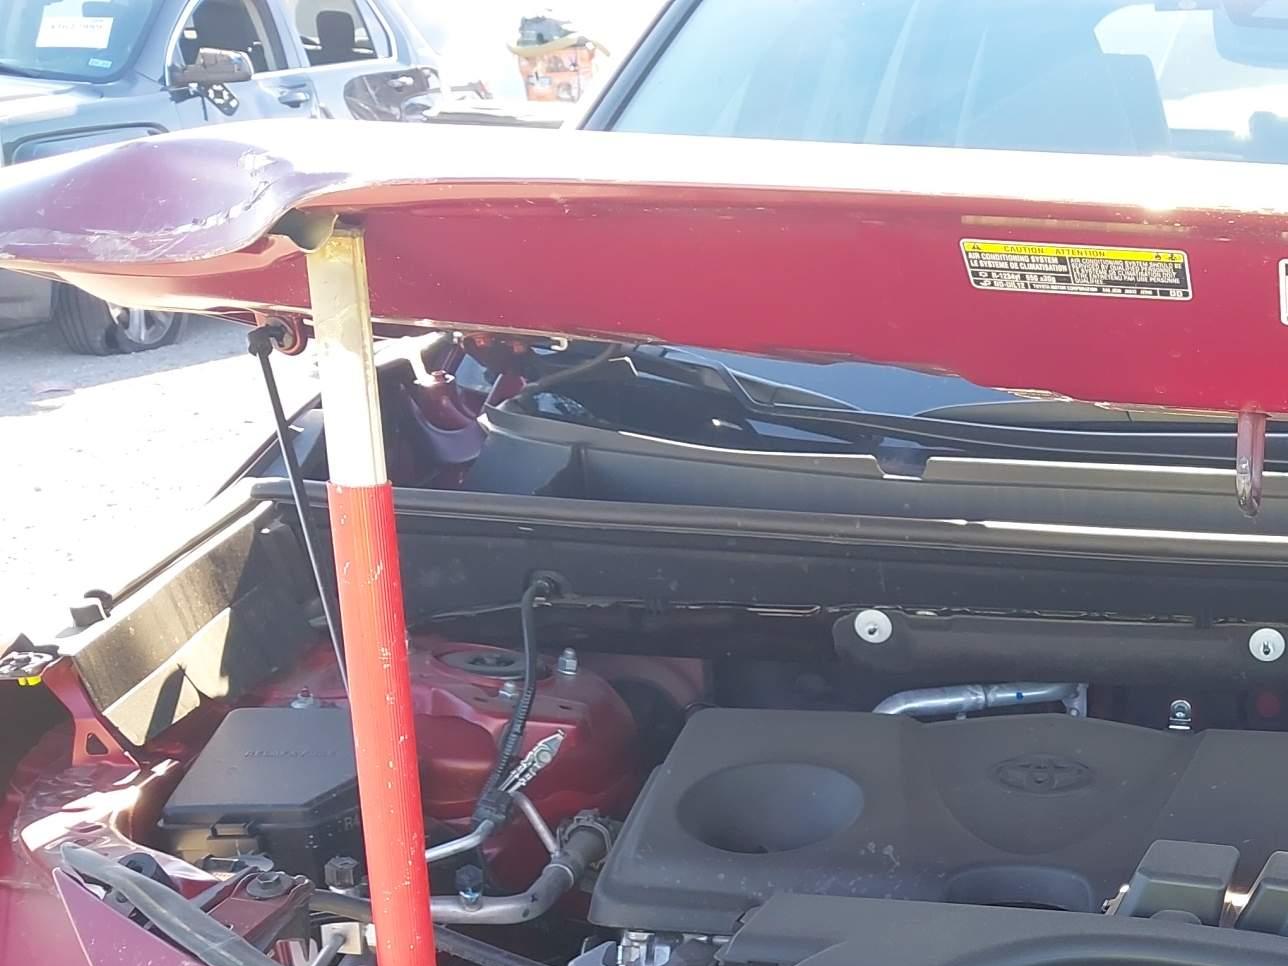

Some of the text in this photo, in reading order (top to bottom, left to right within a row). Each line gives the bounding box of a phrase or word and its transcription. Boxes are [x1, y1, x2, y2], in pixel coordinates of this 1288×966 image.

[1004, 245, 1105, 258] CAUTION ATTENTION
[968, 252, 1057, 264] AIR CONDITIONING SYSTEM
